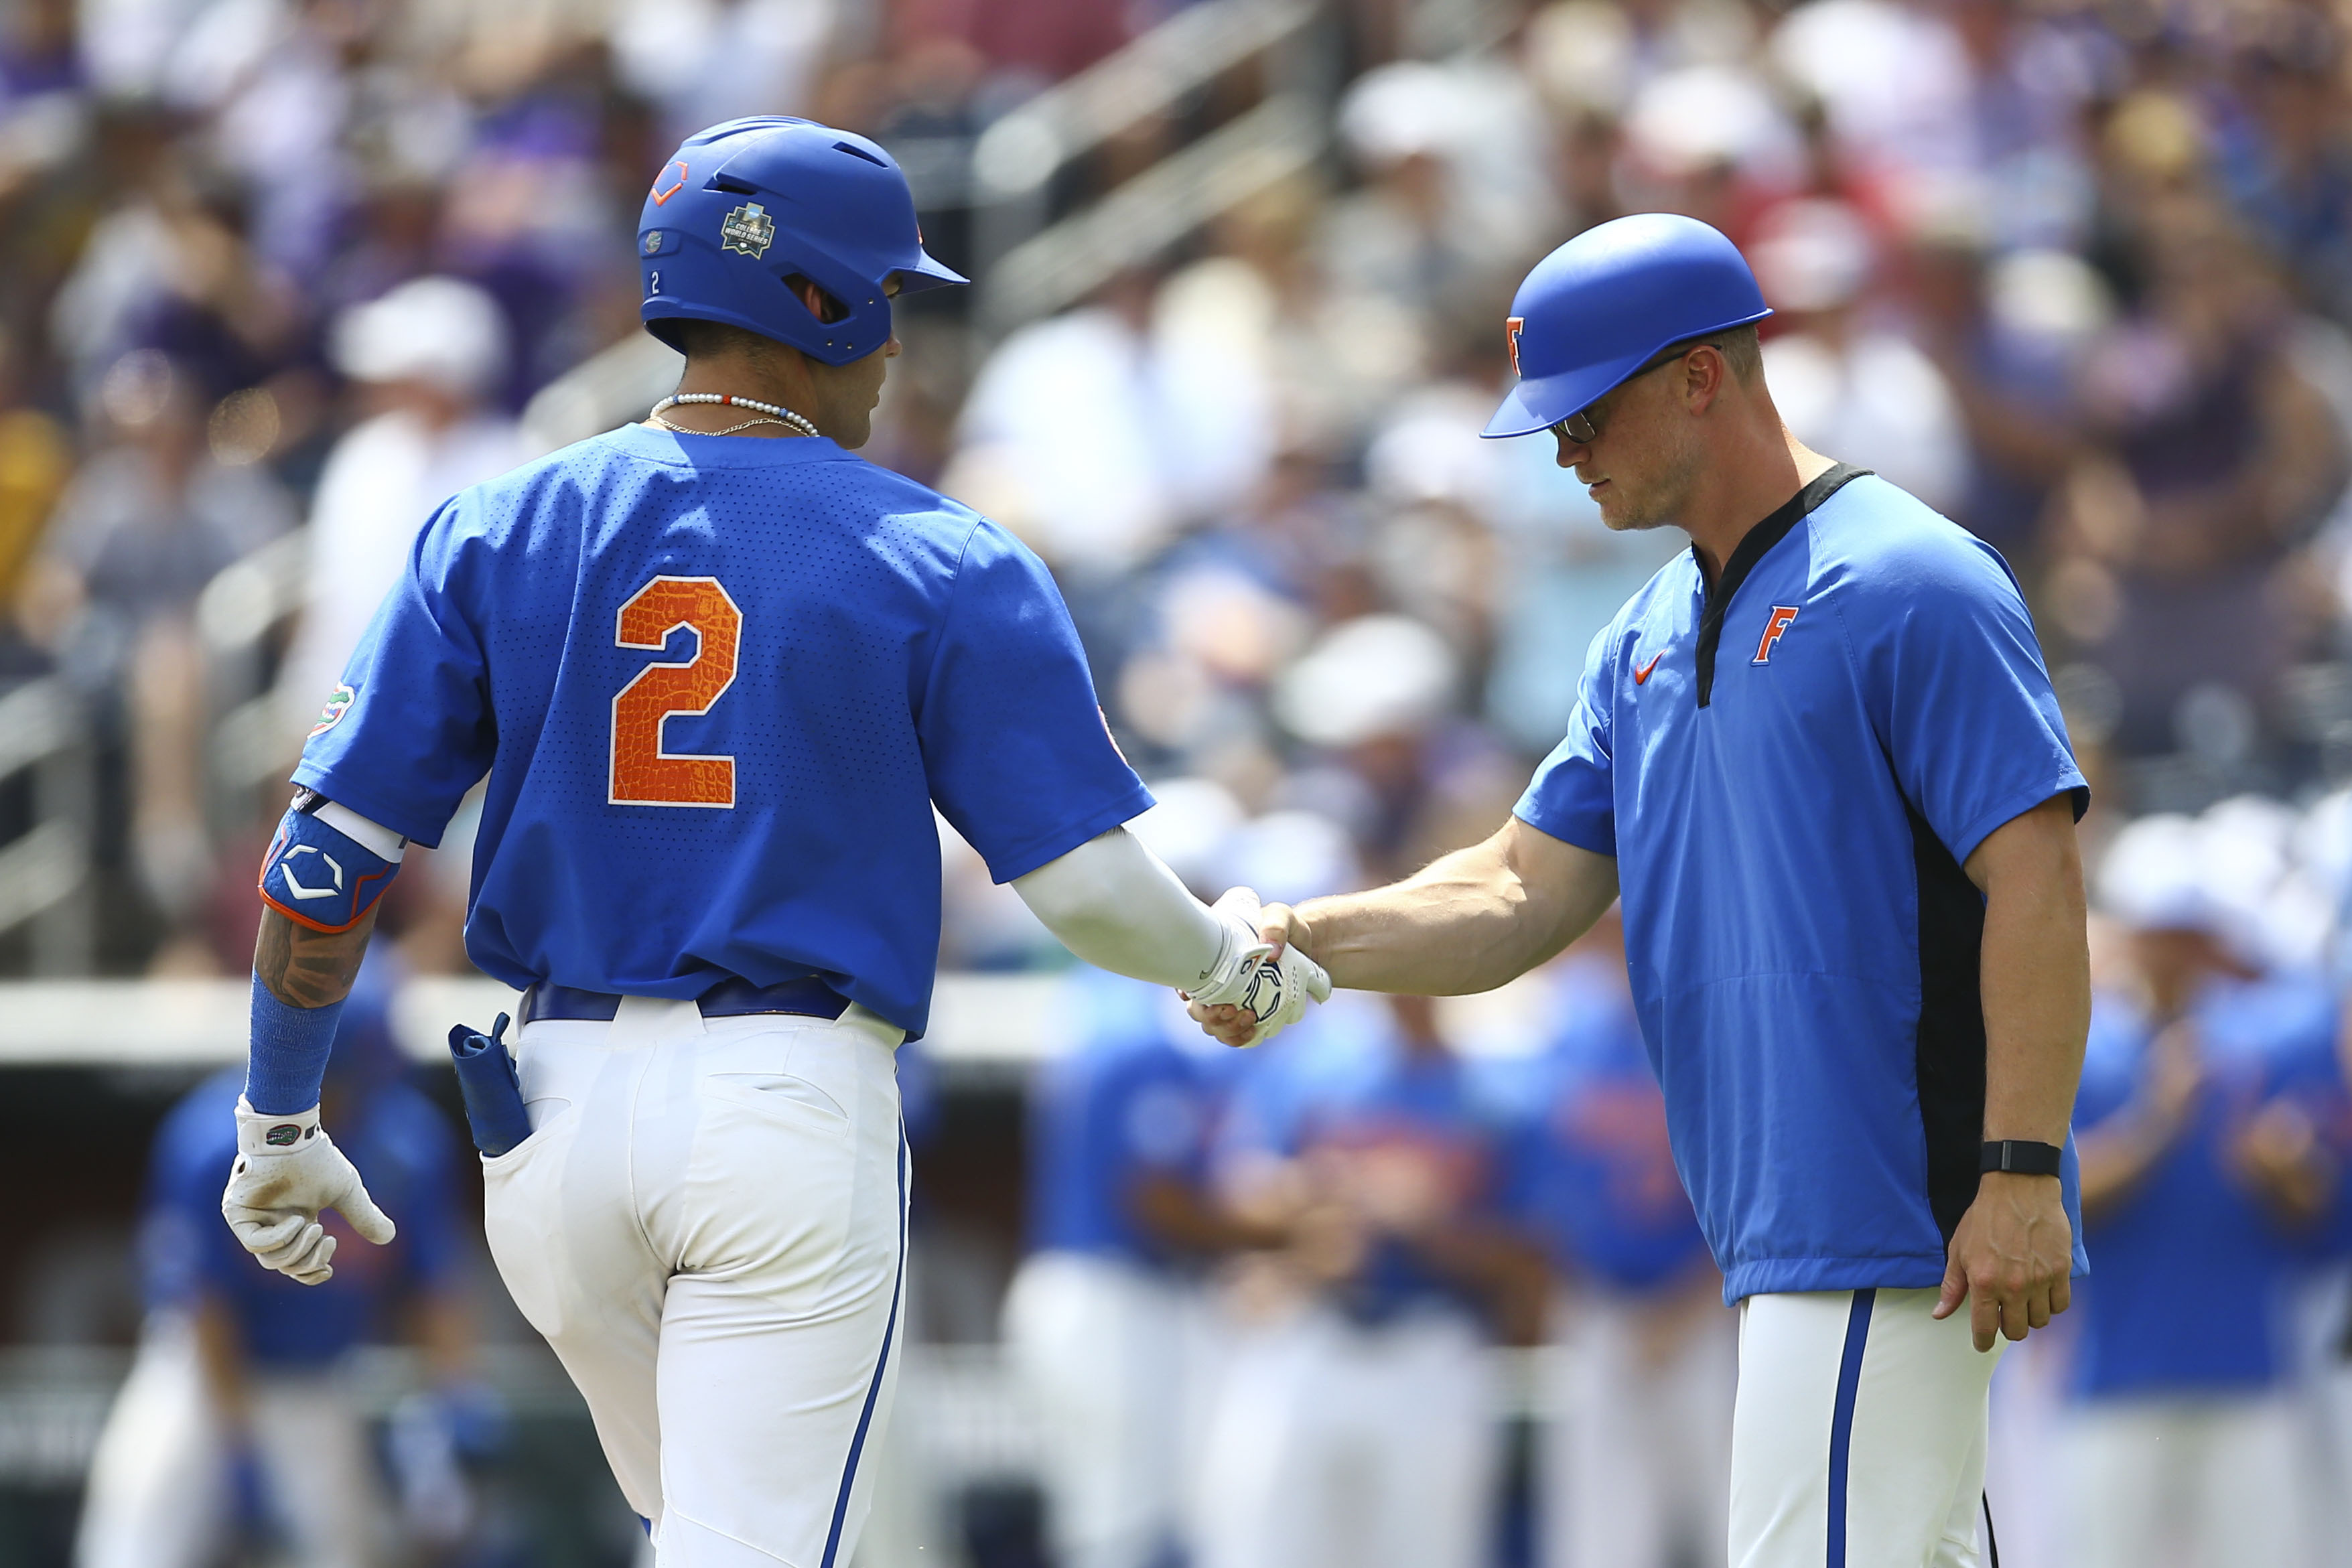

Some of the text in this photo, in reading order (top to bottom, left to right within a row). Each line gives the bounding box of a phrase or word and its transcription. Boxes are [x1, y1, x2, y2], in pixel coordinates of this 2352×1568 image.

[725, 227, 746, 238] WORLD
[746, 233, 768, 244] SERIES
[651, 271, 659, 294] 2
[1751, 605, 1800, 664] F
[608, 575, 744, 809] 2
